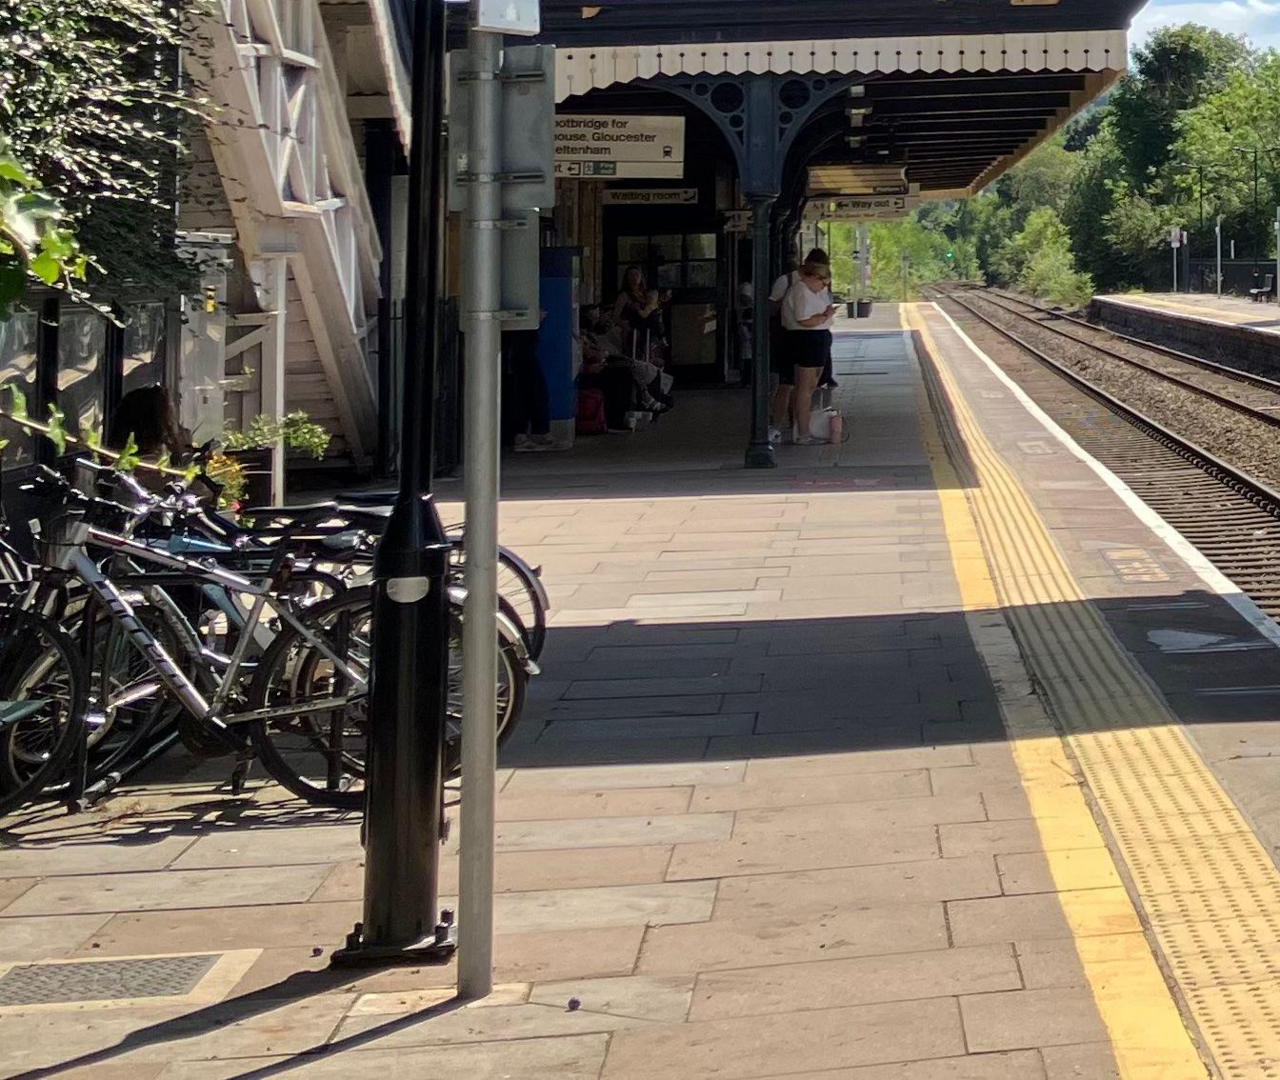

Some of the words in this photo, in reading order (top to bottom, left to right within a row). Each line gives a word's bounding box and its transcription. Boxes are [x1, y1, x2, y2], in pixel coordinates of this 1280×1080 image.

[612, 119, 628, 128] for
[592, 131, 656, 142] Gloucester
[555, 145, 611, 155] eltenham
[611, 191, 650, 201] Waiting
[653, 192, 680, 200] room
[852, 200, 873, 208] Way
